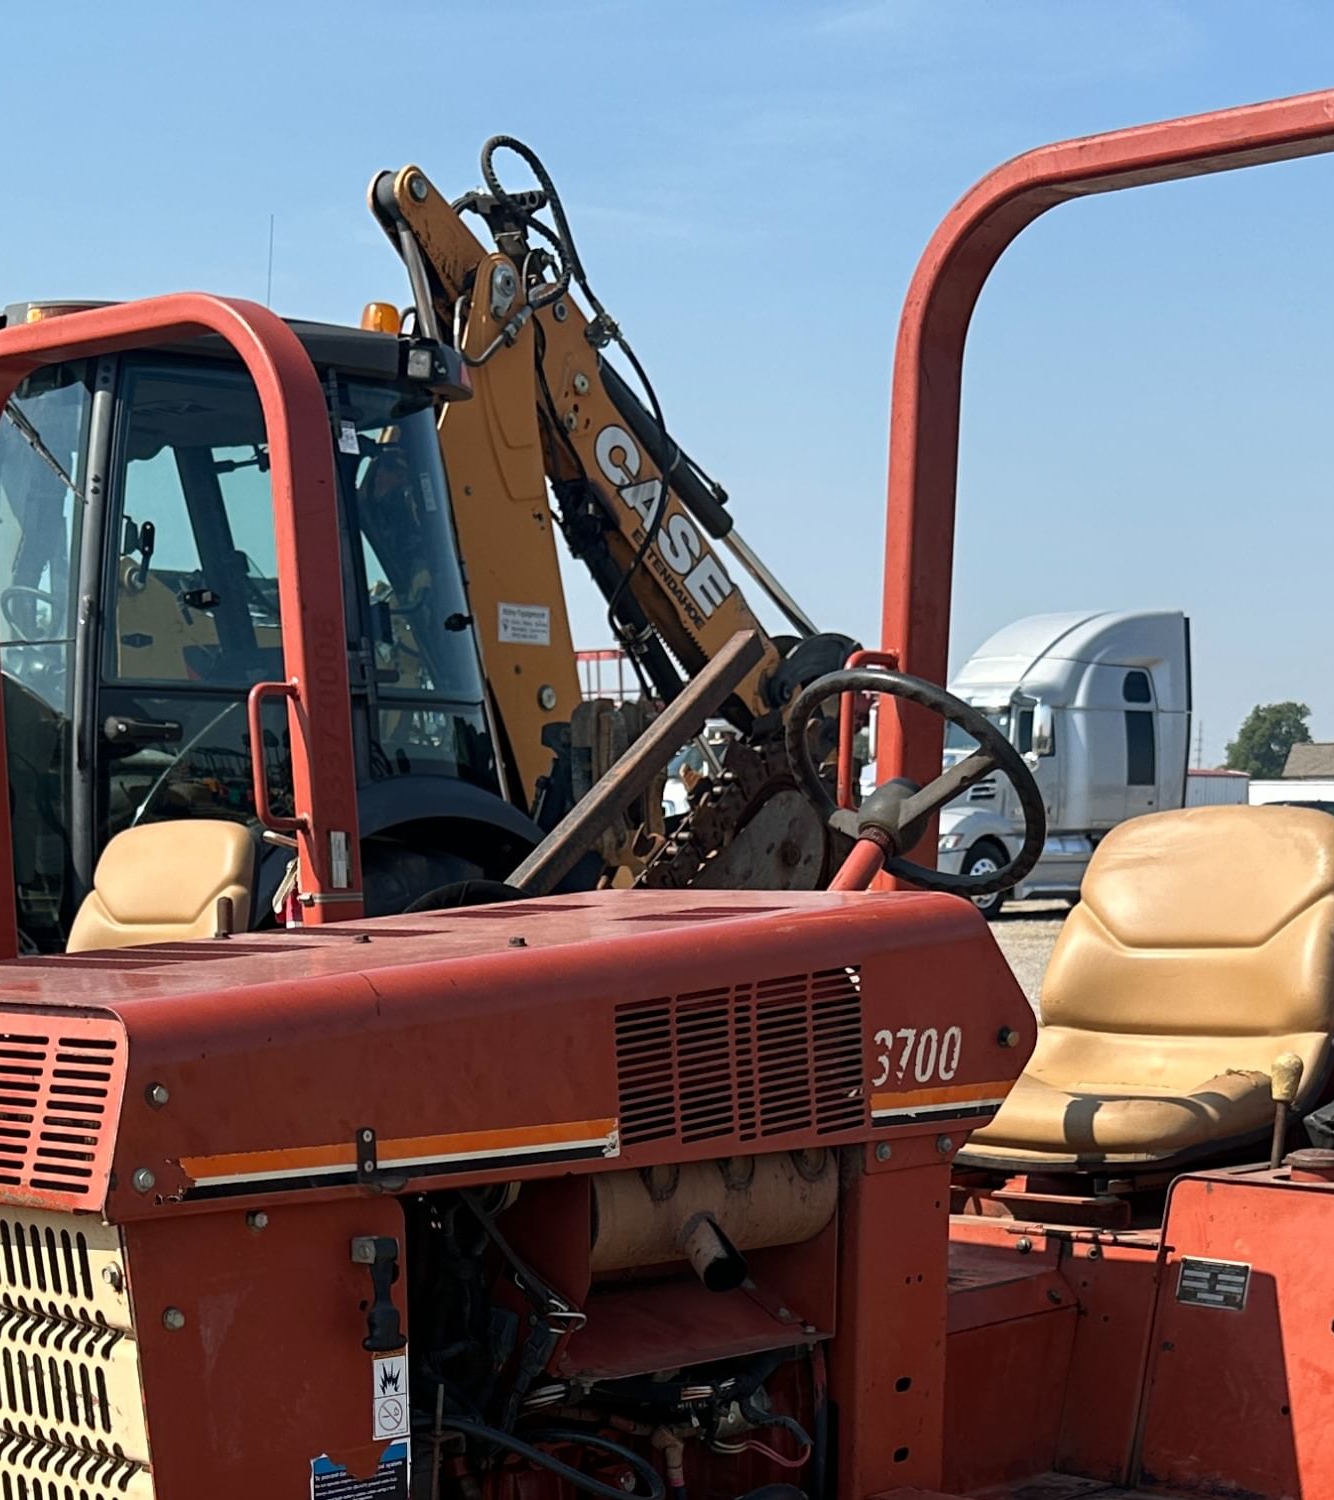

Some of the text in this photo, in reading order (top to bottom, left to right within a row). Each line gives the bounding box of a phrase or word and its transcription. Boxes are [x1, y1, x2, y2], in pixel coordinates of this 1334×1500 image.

[594, 424, 733, 620] CASE
[632, 528, 706, 630] ETENDAHOE
[871, 1026, 962, 1087] 3700
